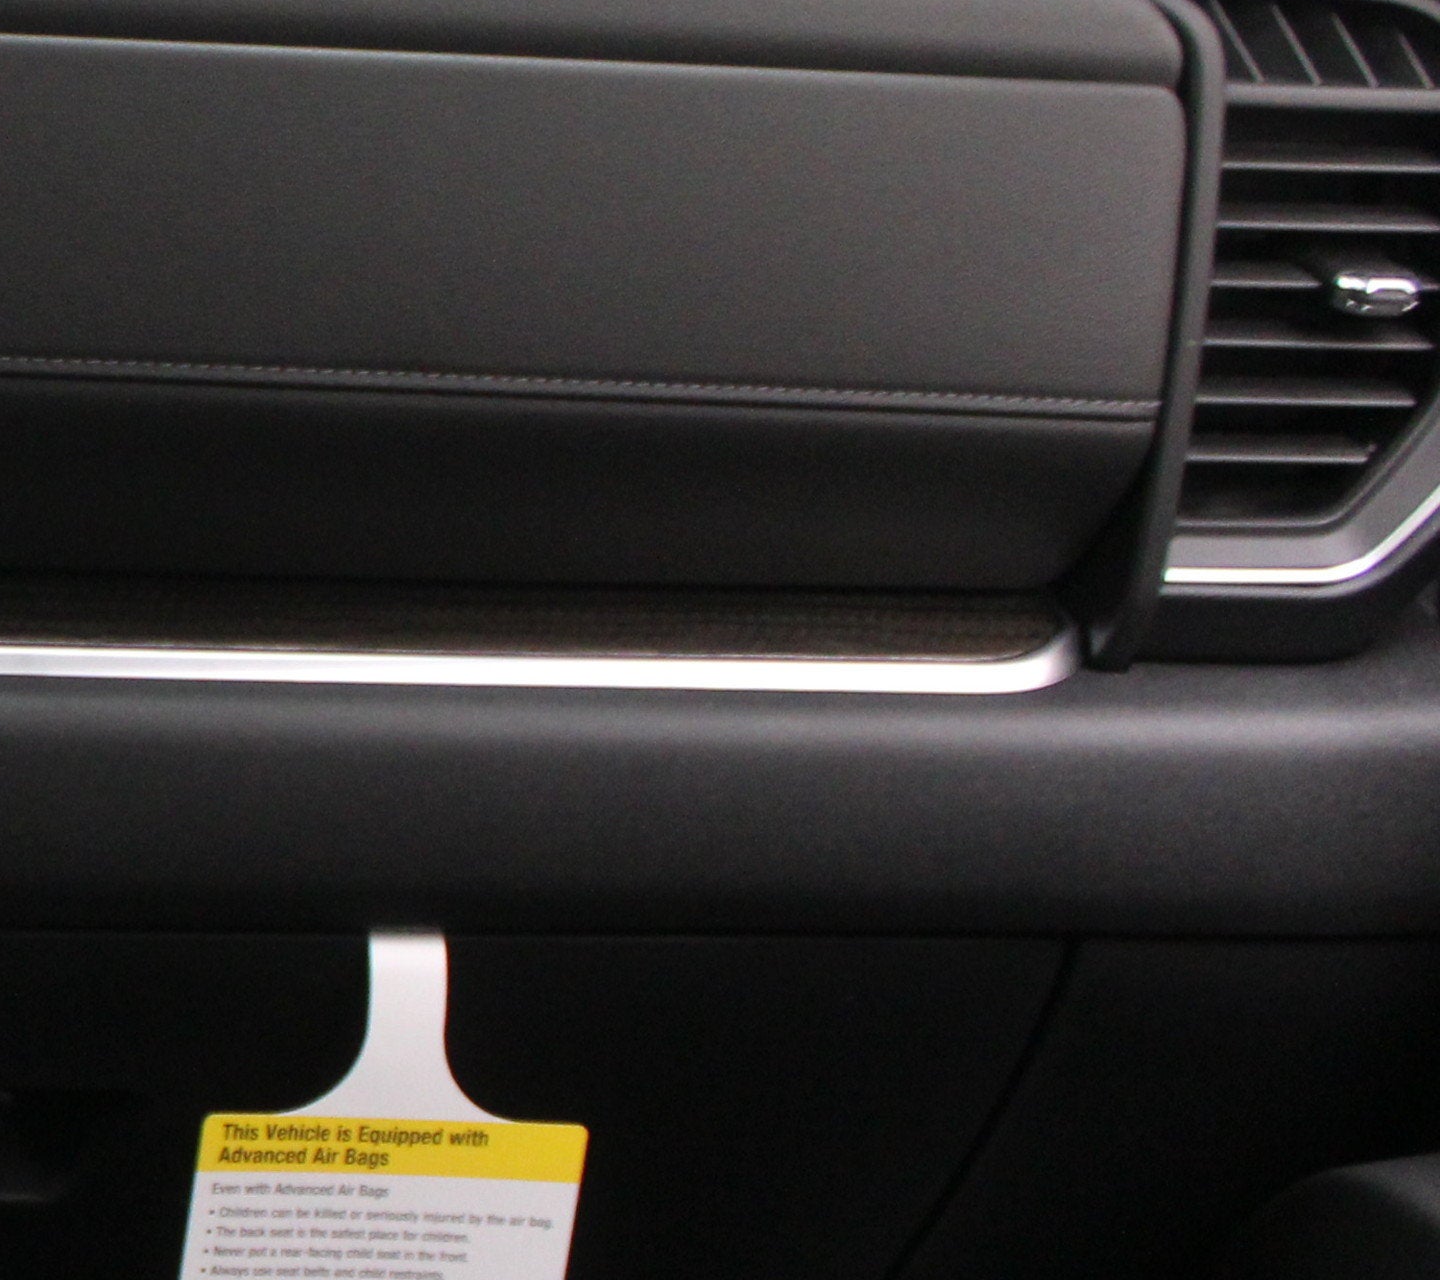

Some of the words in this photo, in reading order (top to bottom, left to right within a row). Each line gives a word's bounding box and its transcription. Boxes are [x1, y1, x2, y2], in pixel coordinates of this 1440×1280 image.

[223, 1124, 259, 1141] This
[266, 1124, 330, 1142] Vehicle
[337, 1126, 352, 1142] is
[358, 1126, 444, 1147] Equipped
[449, 1128, 489, 1147] with
[219, 1147, 308, 1164] Advanced
[312, 1148, 338, 1164] Air
[344, 1148, 389, 1169] Bags
[212, 1183, 241, 1195] Even
[244, 1183, 270, 1195] with
[275, 1184, 333, 1196] Advanced
[338, 1185, 354, 1196] Air
[359, 1185, 389, 1199] Bags
